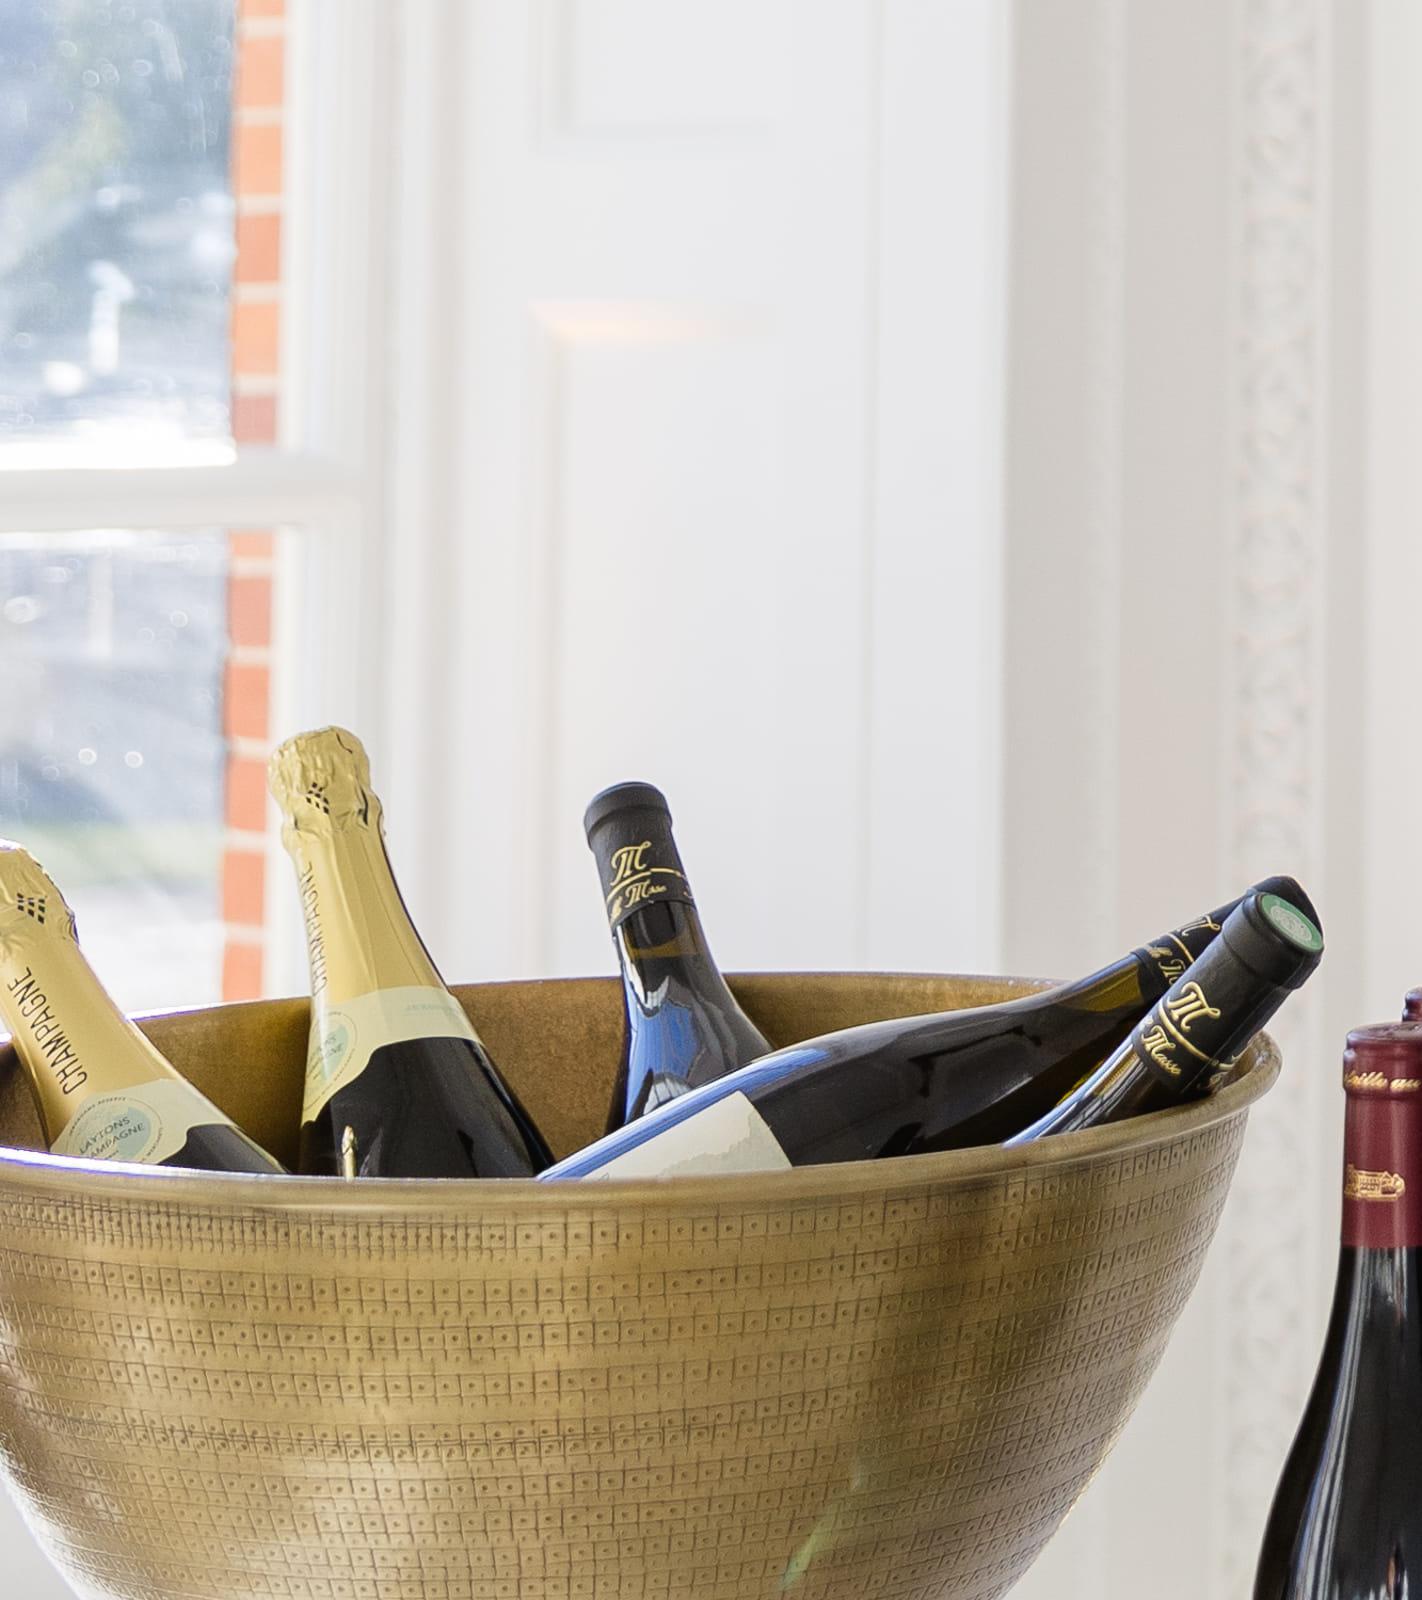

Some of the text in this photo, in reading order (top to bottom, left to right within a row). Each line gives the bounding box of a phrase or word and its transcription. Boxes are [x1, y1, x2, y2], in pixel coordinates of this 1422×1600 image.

[7, 966, 88, 1096] CHAMPAGNE
[80, 1116, 131, 1155] LAYTONS
[90, 1122, 146, 1158] AMPAGNE
